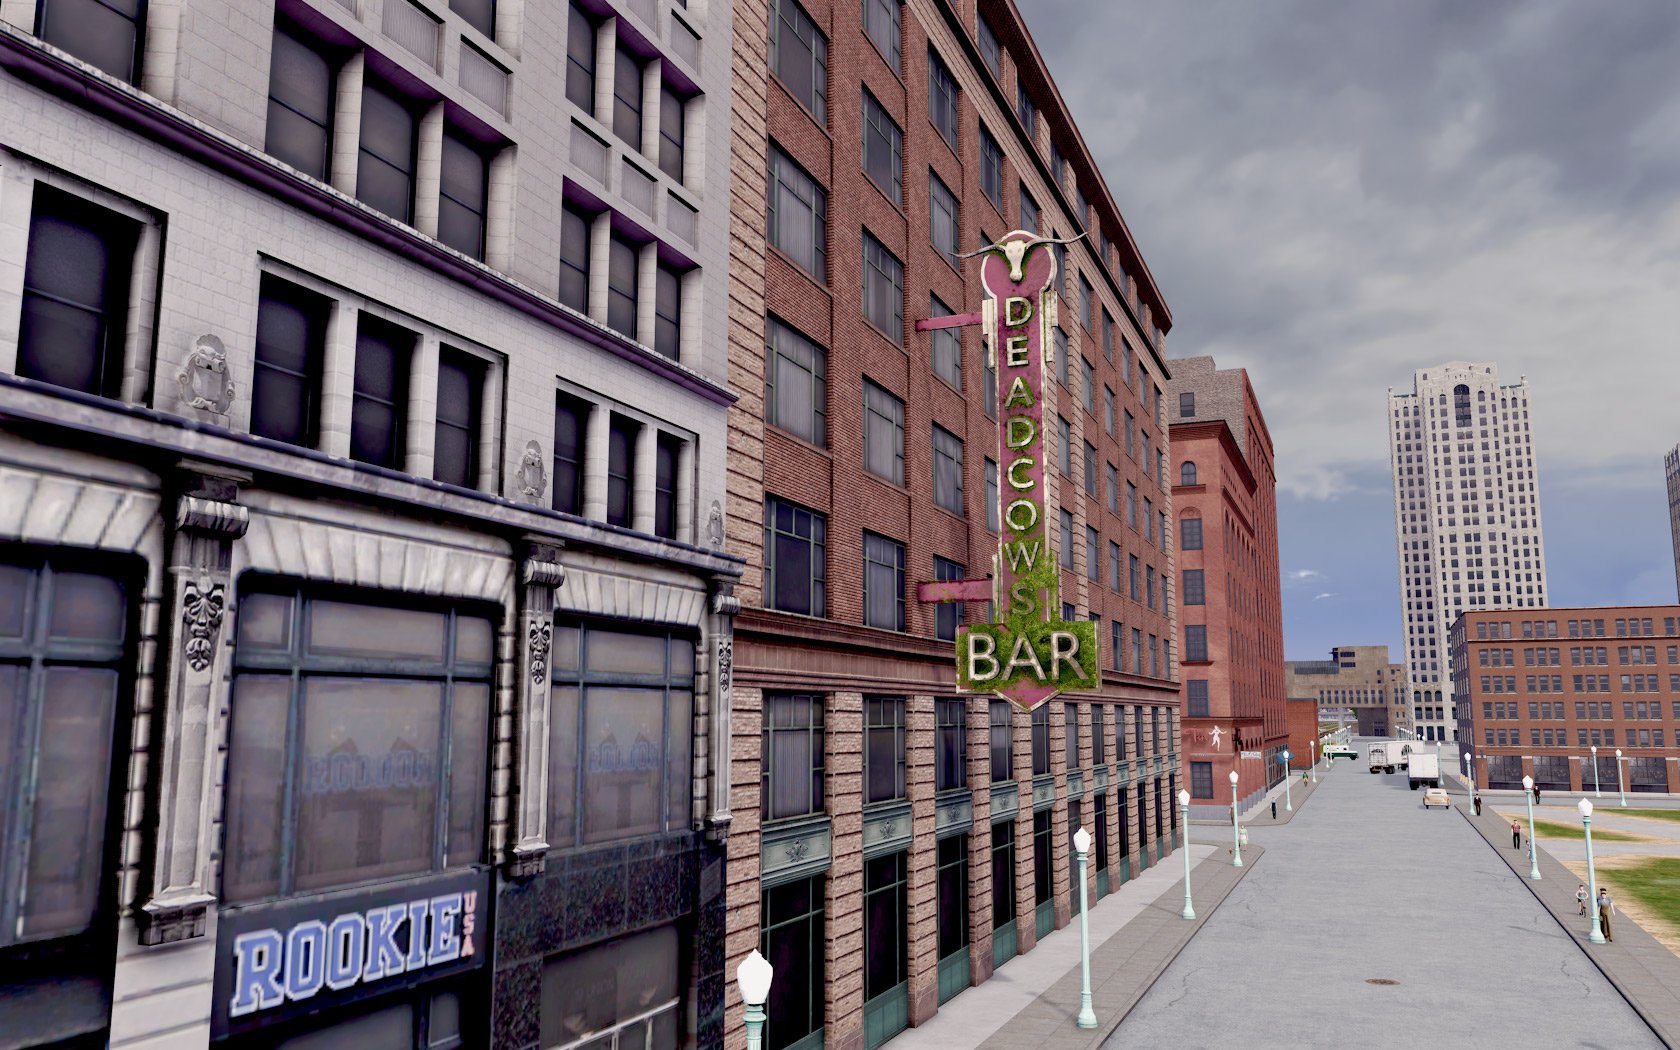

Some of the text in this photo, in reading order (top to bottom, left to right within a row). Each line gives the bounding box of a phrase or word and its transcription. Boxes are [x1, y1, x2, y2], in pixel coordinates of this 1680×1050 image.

[967, 632, 1088, 681] BAR
[230, 893, 463, 1017] ROOKIE
[461, 890, 477, 956] USA
